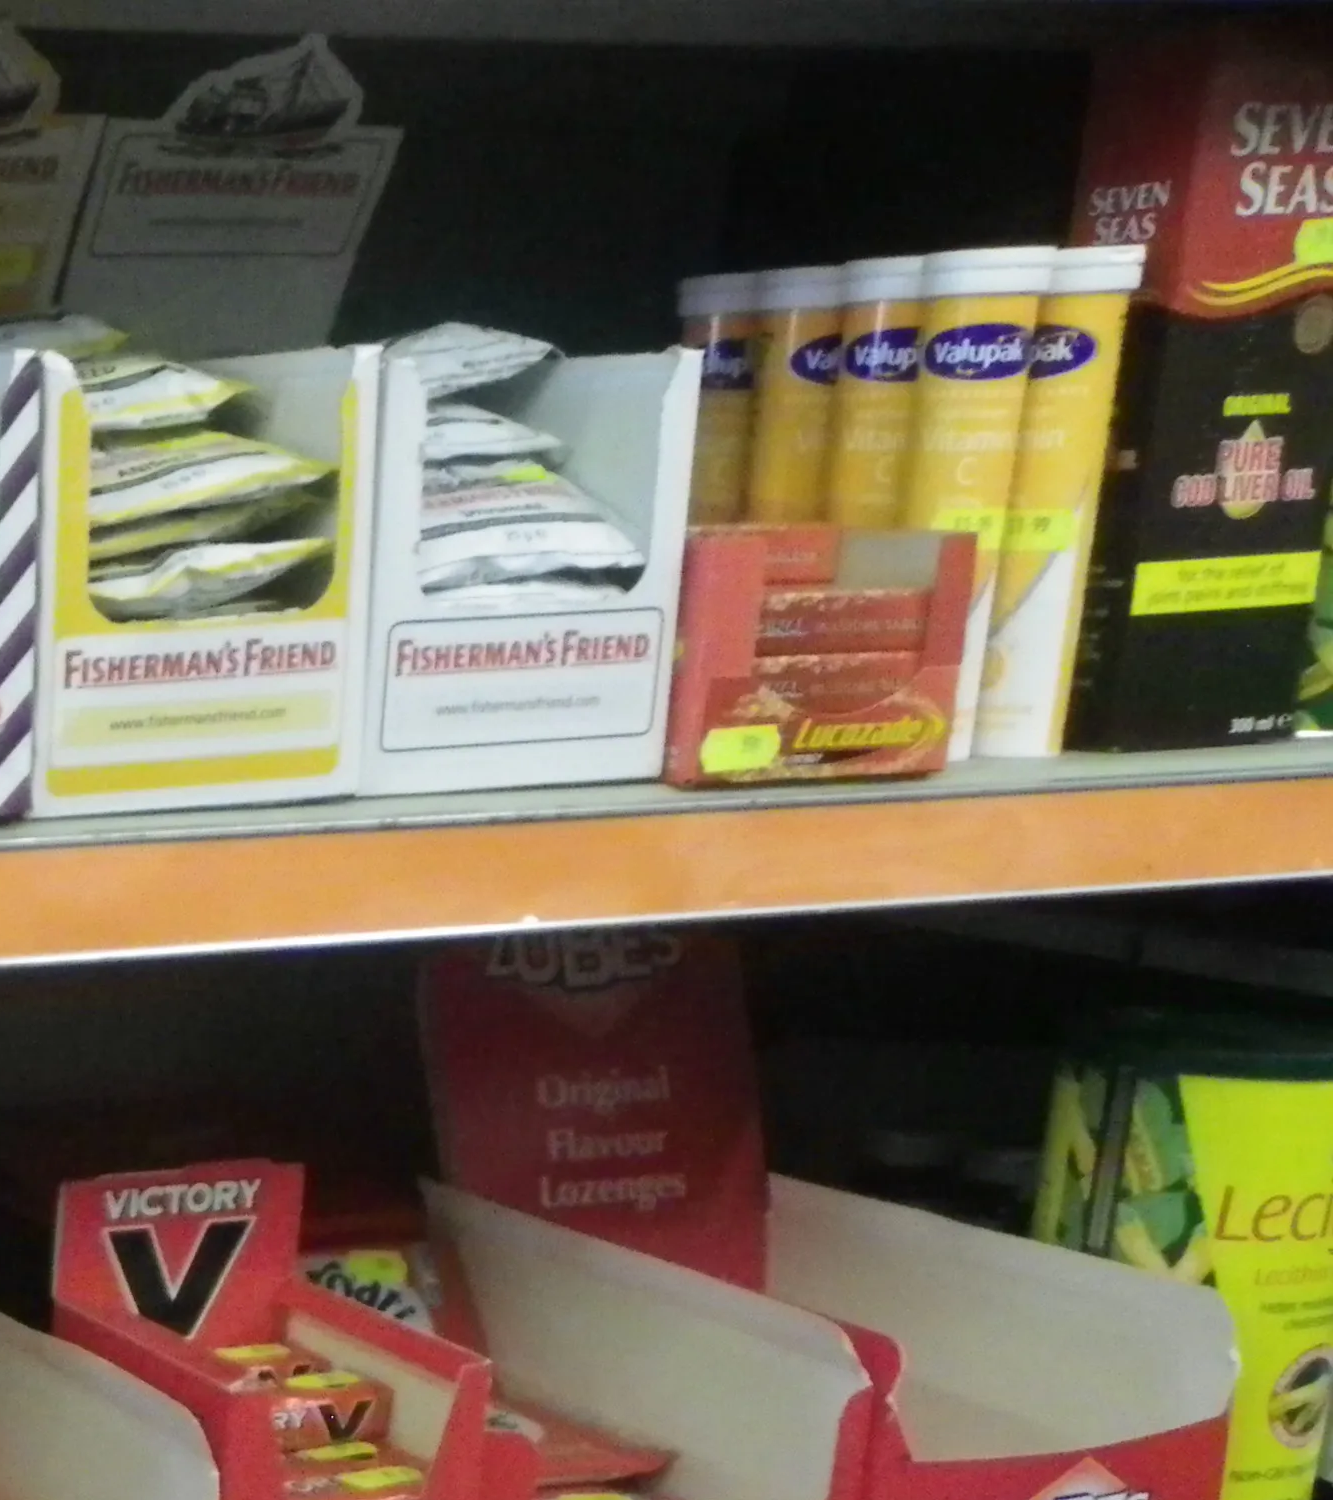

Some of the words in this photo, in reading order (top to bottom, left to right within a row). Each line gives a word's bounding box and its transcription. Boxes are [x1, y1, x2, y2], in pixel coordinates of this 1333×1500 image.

[1089, 181, 1171, 216] SEVEN
[1094, 212, 1157, 245] SEAS
[64, 640, 240, 689] FISHERMAN'S
[243, 638, 335, 678] FRIEND
[396, 633, 556, 678] FISHERMAN'S
[561, 627, 649, 666] FRIEND
[794, 718, 925, 750] Lucozade
[537, 1066, 670, 1115] Original
[547, 1129, 667, 1162] Flavour
[105, 1179, 261, 1221] VICTORY
[538, 1173, 687, 1212] Lozenges
